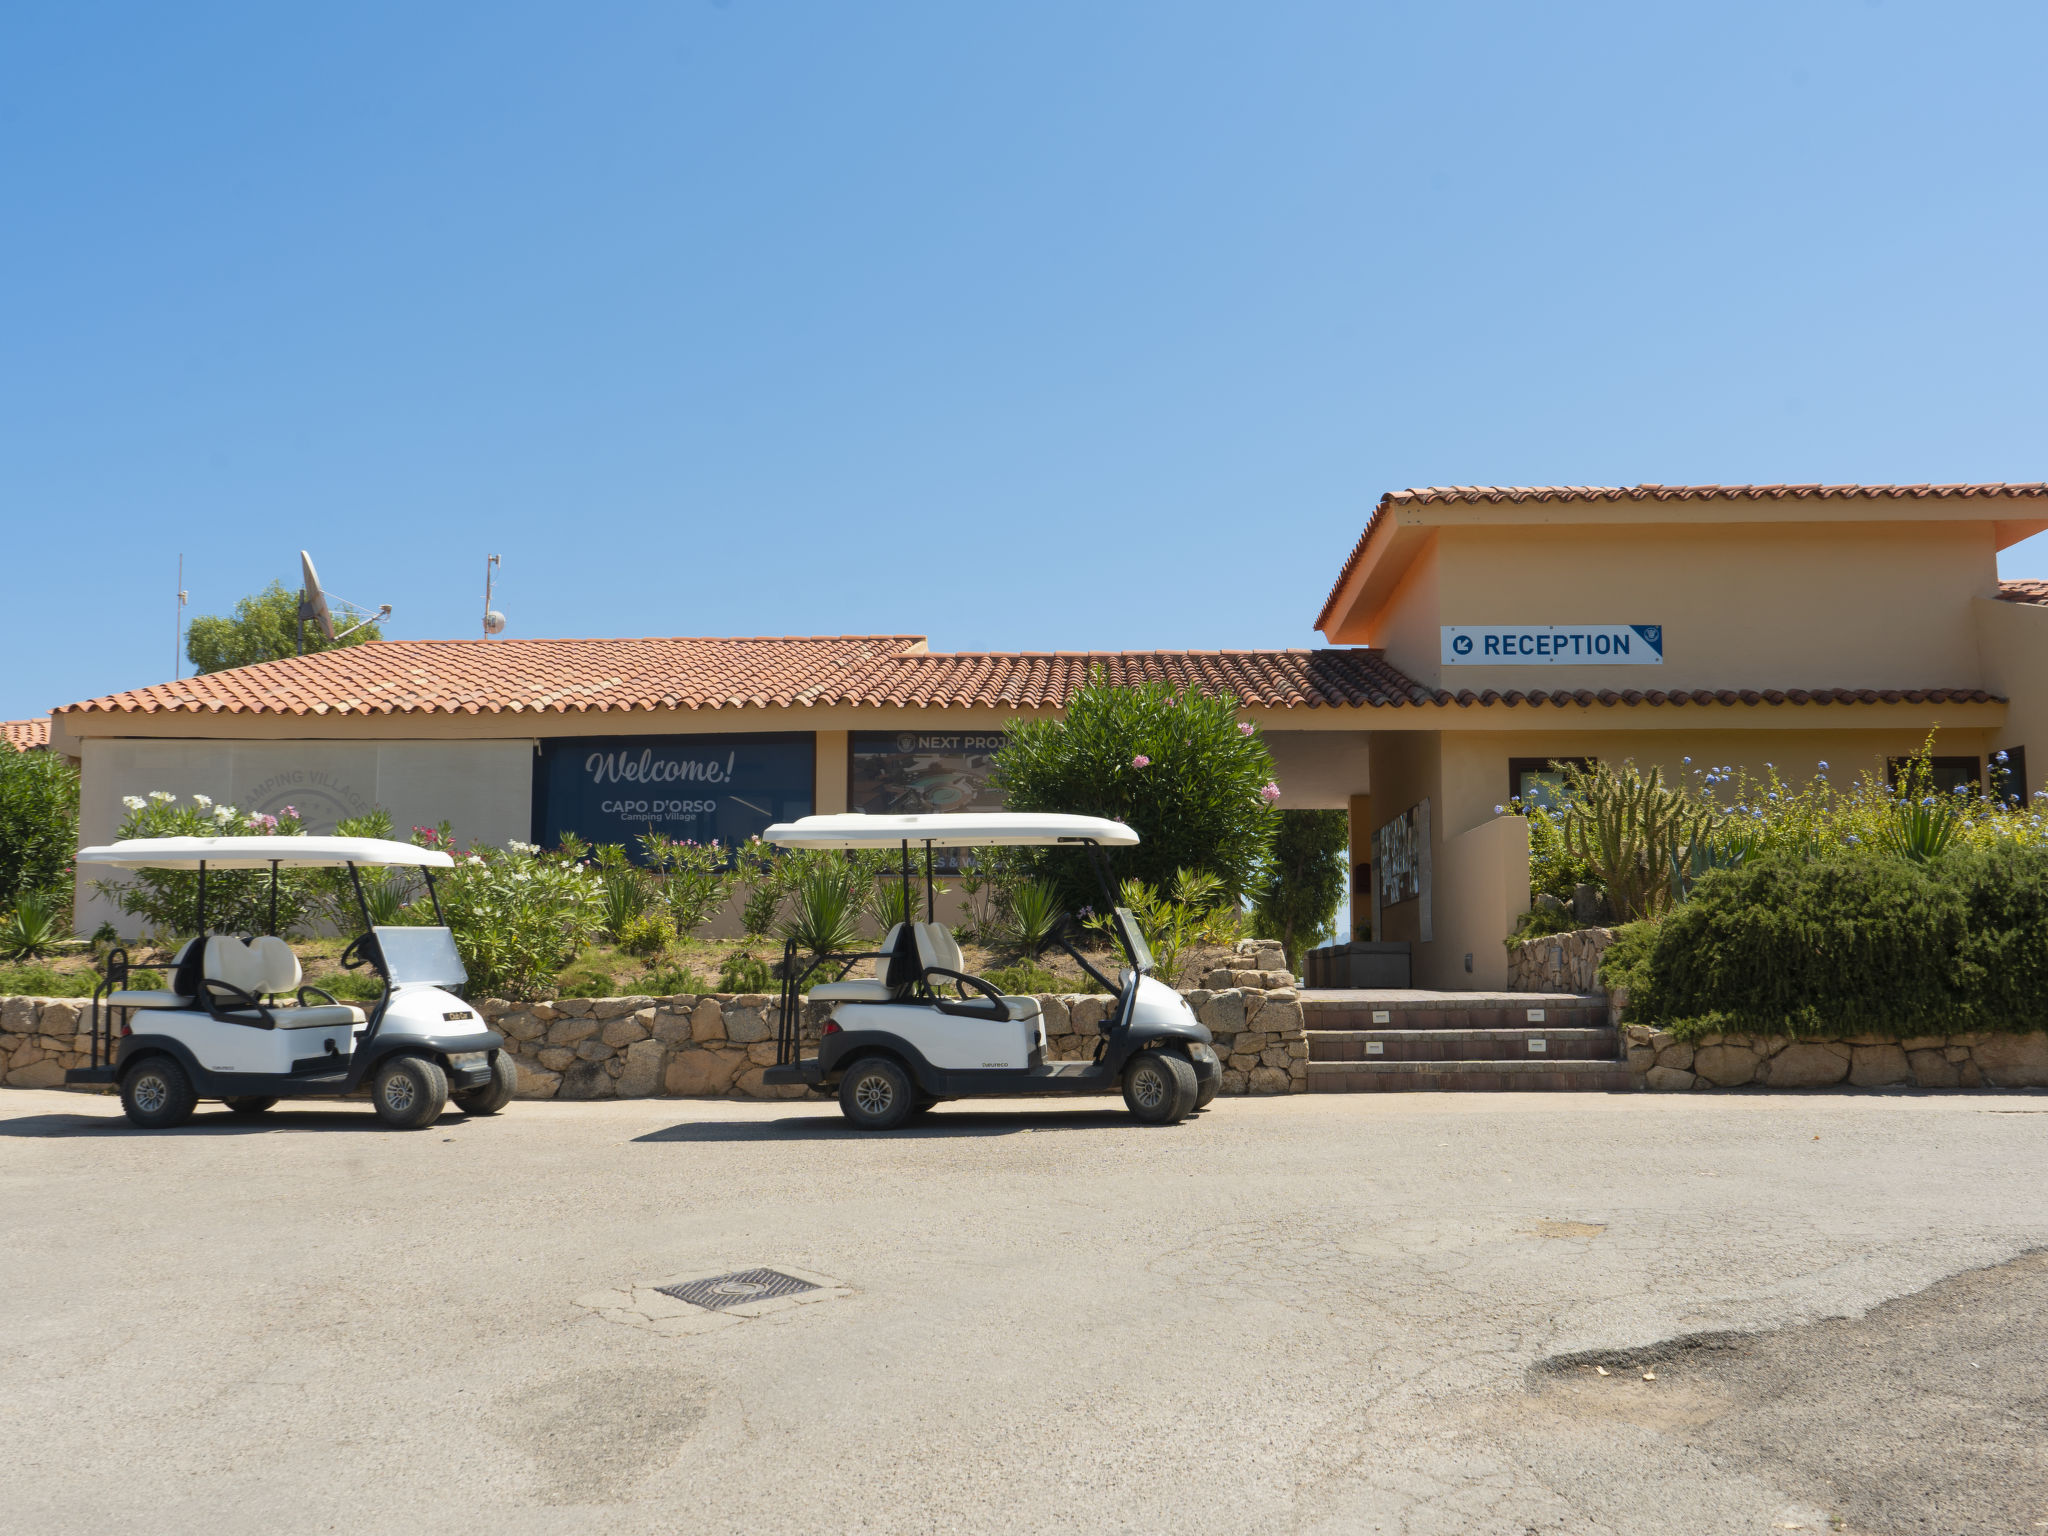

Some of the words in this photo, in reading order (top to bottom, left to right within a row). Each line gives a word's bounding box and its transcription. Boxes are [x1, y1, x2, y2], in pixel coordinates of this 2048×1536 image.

[1484, 634, 1630, 655] RECEPTION
[919, 737, 960, 749] NEXT
[585, 748, 735, 784] Welcome!
[310, 770, 369, 814] VILLAGE
[601, 800, 649, 813] CAPO
[653, 800, 716, 813] D'ORSO
[620, 813, 663, 822] Camping
[664, 813, 697, 822] Village
